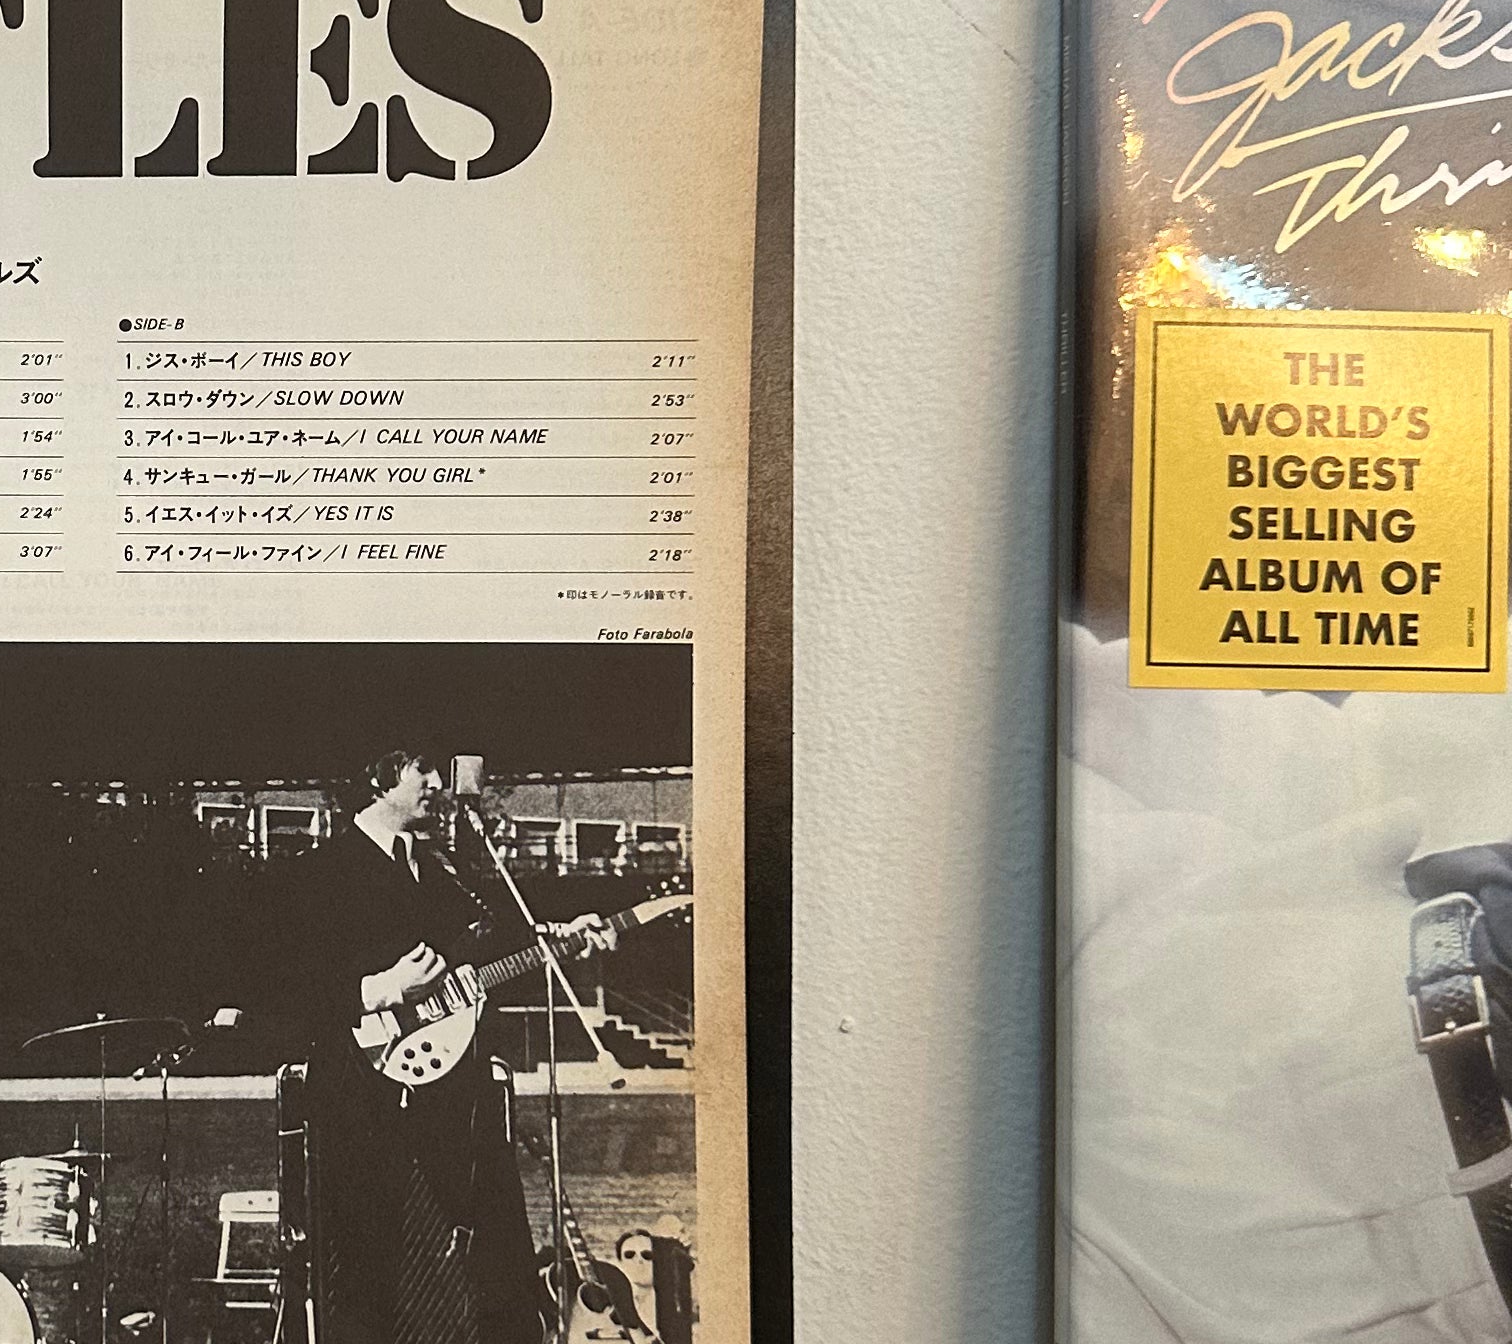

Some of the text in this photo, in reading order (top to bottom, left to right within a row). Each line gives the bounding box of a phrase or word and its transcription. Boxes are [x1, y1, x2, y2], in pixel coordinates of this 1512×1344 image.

[261, 351, 304, 367] THIS
[309, 351, 353, 368] BOY
[1282, 351, 1365, 387] THE
[273, 390, 334, 406] SLOW
[339, 389, 405, 406] DOWN
[1214, 402, 1431, 441] WORLD'S
[359, 428, 367, 444] I
[376, 428, 423, 445] CALL
[432, 428, 485, 445] YOUR
[489, 428, 549, 444] NAME
[312, 467, 379, 483] THANK
[387, 467, 427, 484] YOU
[1227, 454, 1421, 492] BIGGEST
[314, 505, 350, 521] YES
[354, 505, 375, 521] IT
[376, 505, 395, 521] IS
[1228, 505, 1416, 544] SELLING
[340, 544, 348, 560] I
[357, 544, 399, 560] FEEL
[405, 544, 448, 560] FINE
[1198, 557, 1442, 596] ALBUM OF
[598, 628, 693, 641] Foto Farabola
[1218, 610, 1419, 647] ALL TIME
